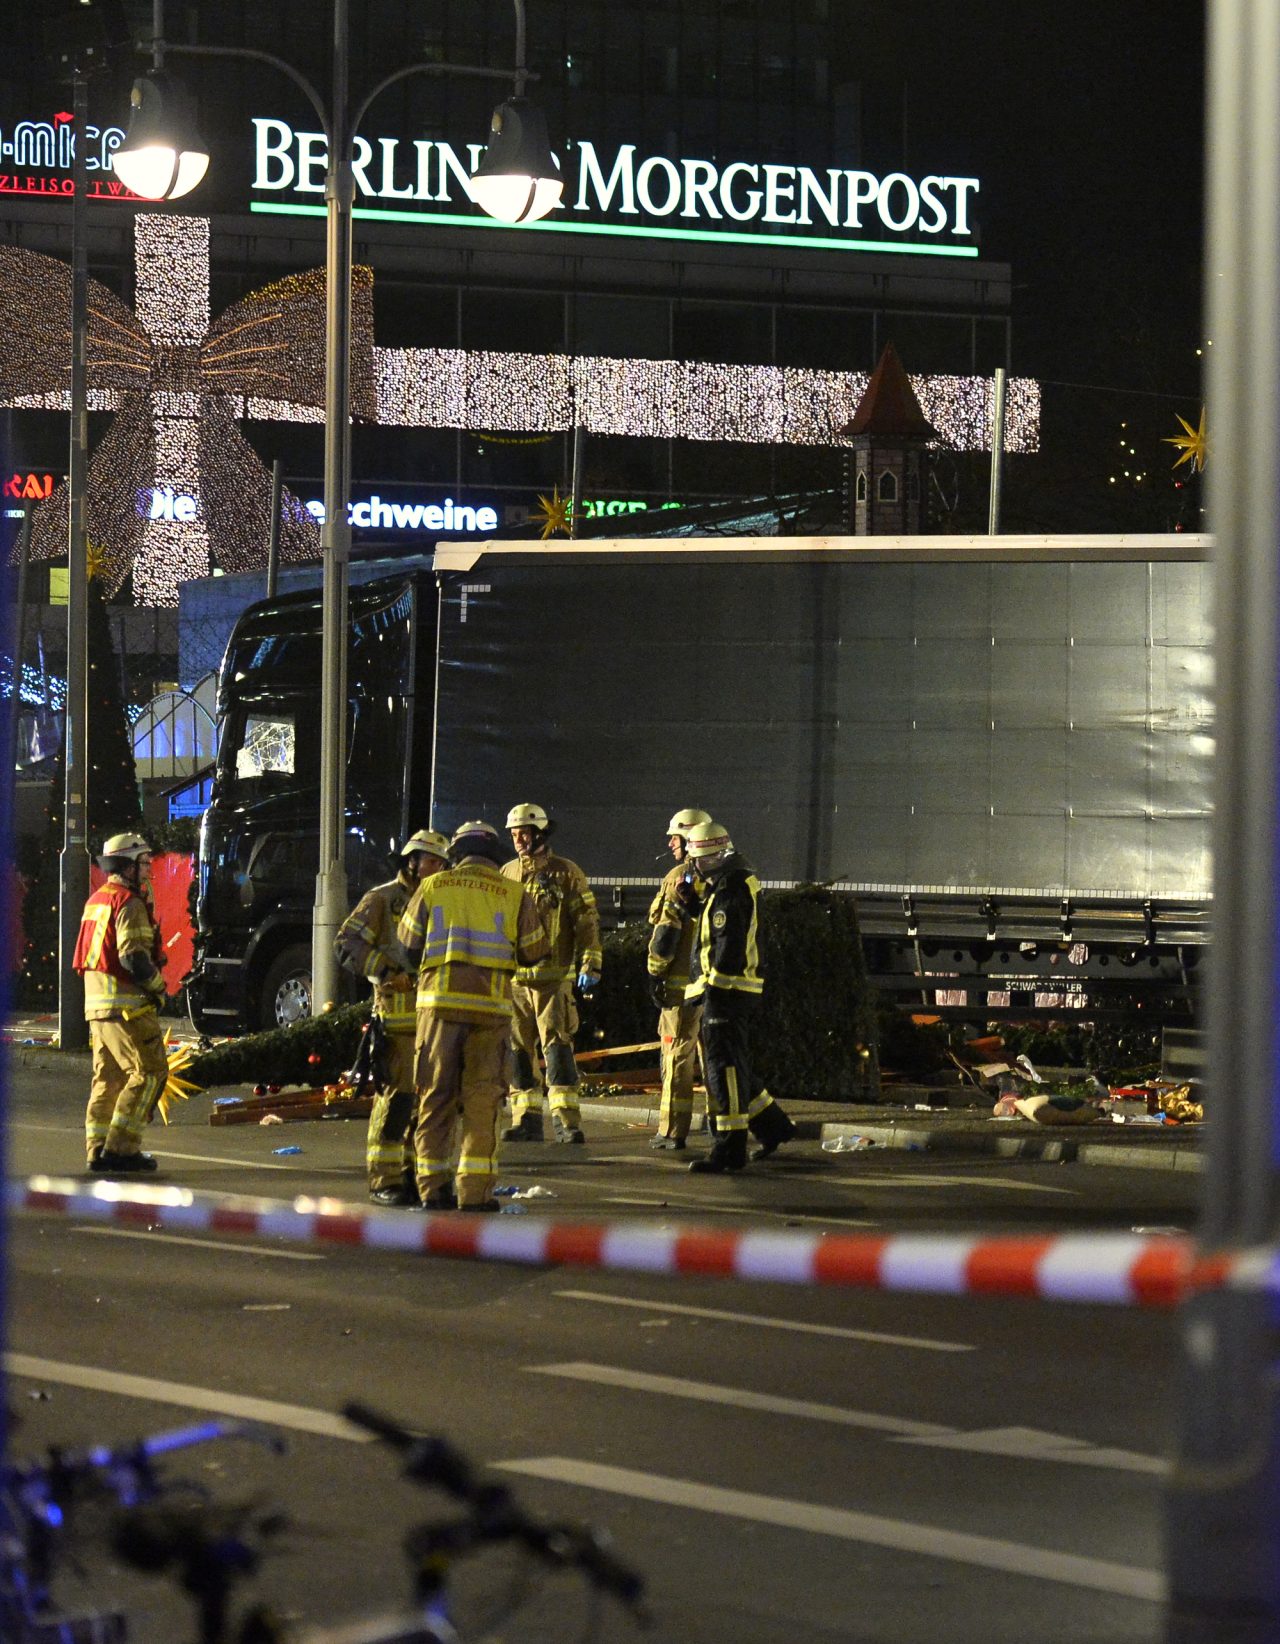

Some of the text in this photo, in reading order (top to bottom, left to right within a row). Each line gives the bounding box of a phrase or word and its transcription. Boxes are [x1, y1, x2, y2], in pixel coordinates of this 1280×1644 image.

[251, 118, 980, 234] BERLIN MORGENPOST
[432, 878, 508, 897] EINSATZLEITER
